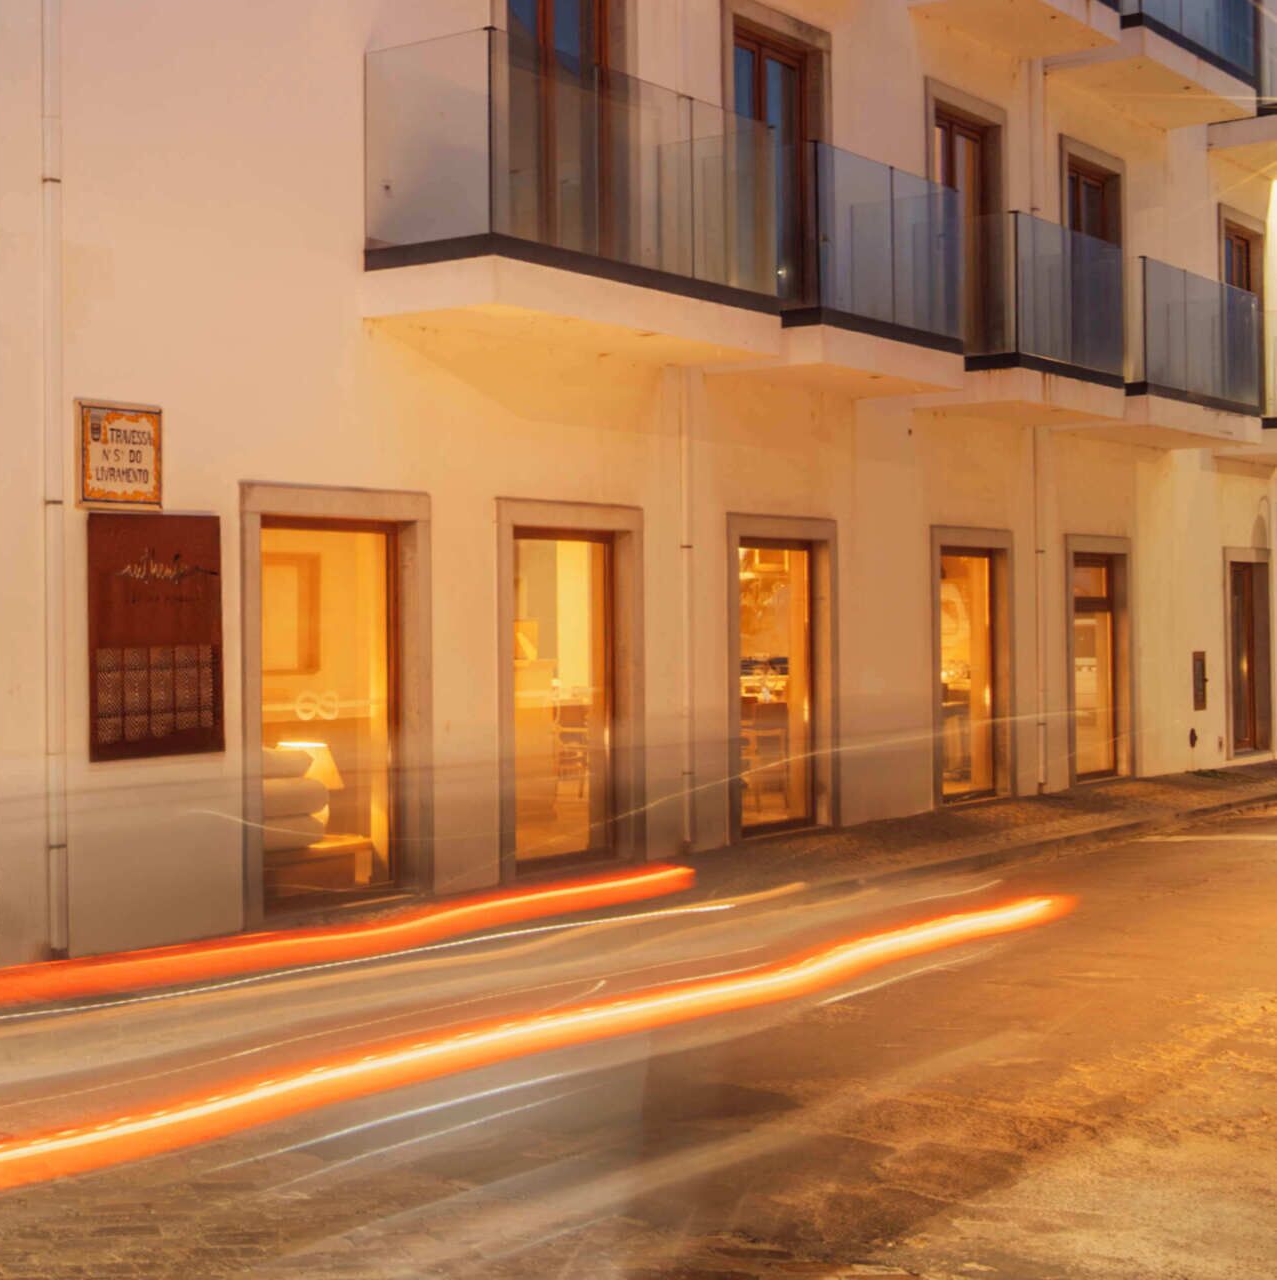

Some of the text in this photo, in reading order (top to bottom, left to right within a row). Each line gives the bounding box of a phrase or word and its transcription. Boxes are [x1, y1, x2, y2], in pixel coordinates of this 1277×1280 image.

[109, 427, 153, 447] TRAVESSA
[129, 449, 143, 465] DO
[95, 466, 150, 485] LIVRAMENTO
